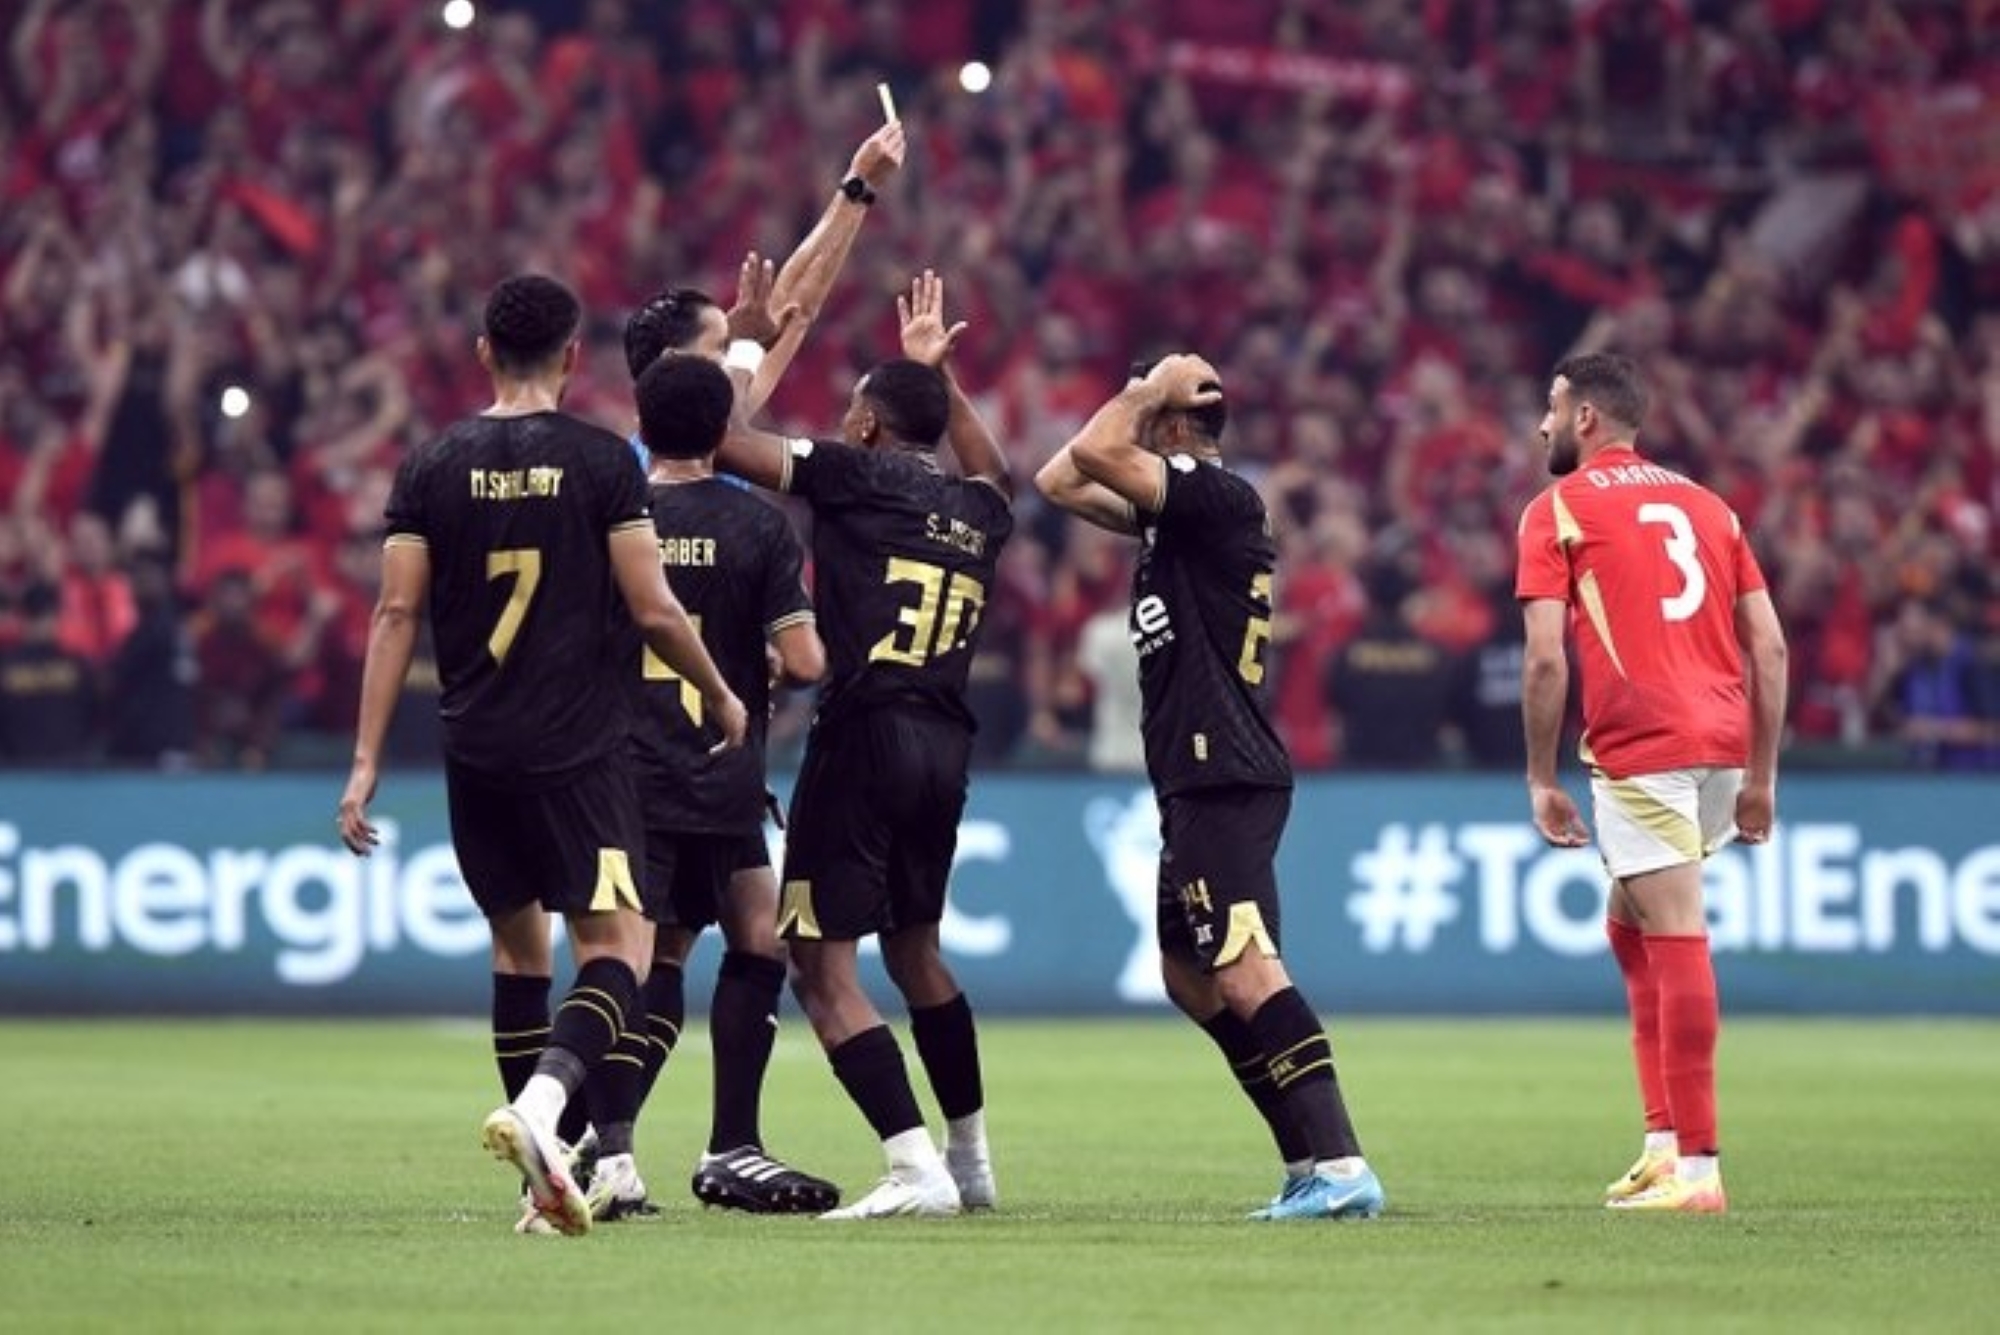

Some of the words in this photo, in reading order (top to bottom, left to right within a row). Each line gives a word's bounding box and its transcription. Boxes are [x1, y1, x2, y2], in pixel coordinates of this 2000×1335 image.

[487, 549, 541, 660] 7
[868, 556, 986, 667] 30
[1638, 503, 1706, 622] 3
[0, 820, 492, 983] nergie
